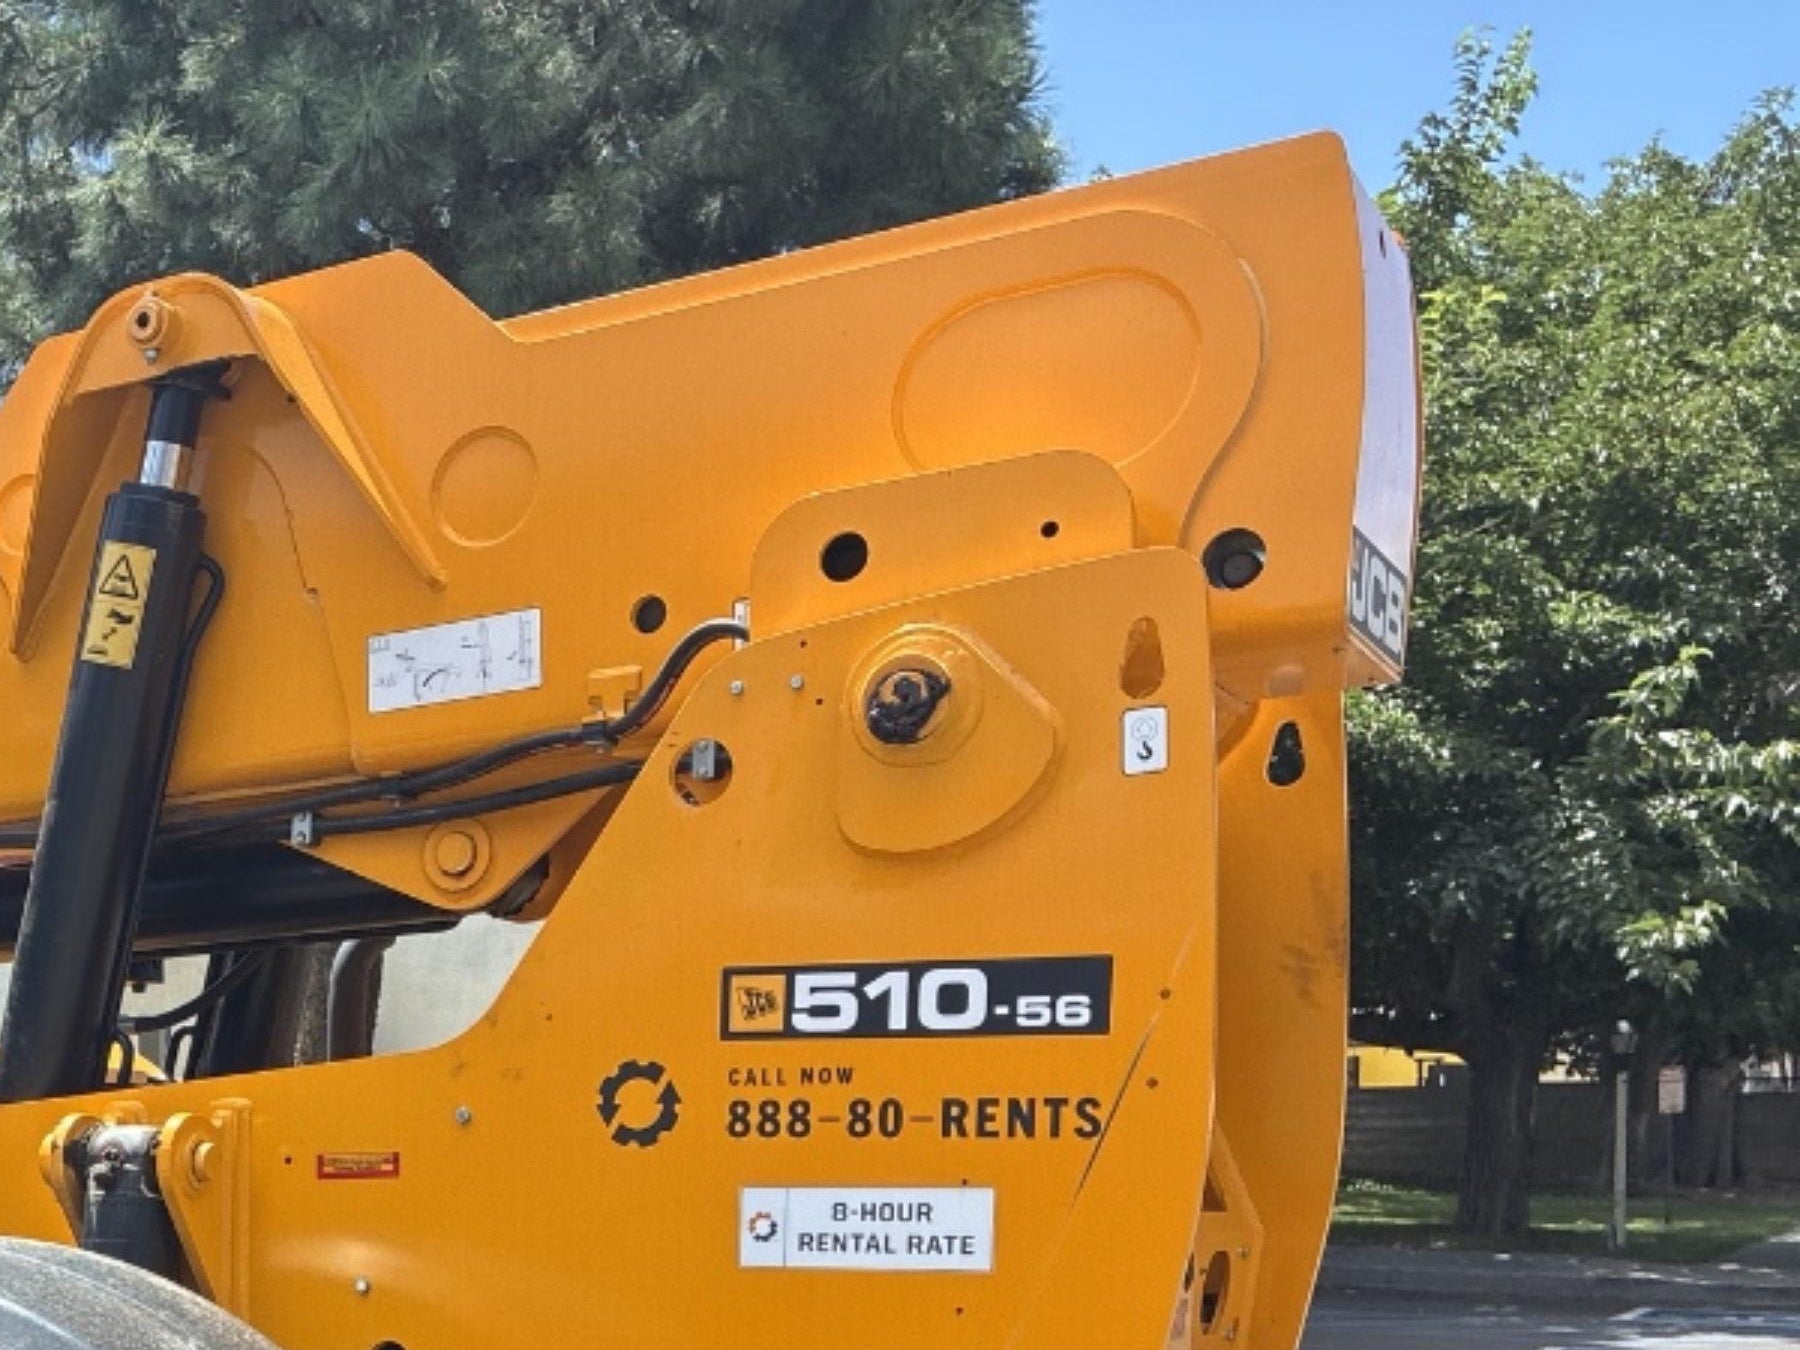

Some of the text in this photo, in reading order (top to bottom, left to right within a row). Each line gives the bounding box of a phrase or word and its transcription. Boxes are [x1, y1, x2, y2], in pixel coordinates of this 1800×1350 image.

[791, 968, 1092, 1033] 510-56
[728, 1066, 855, 1087] CALL NOW
[726, 1096, 1102, 1140] 888-80-RENTS
[831, 1202, 934, 1224] 8-HOUR
[797, 1233, 976, 1256] RENTAL RATE
